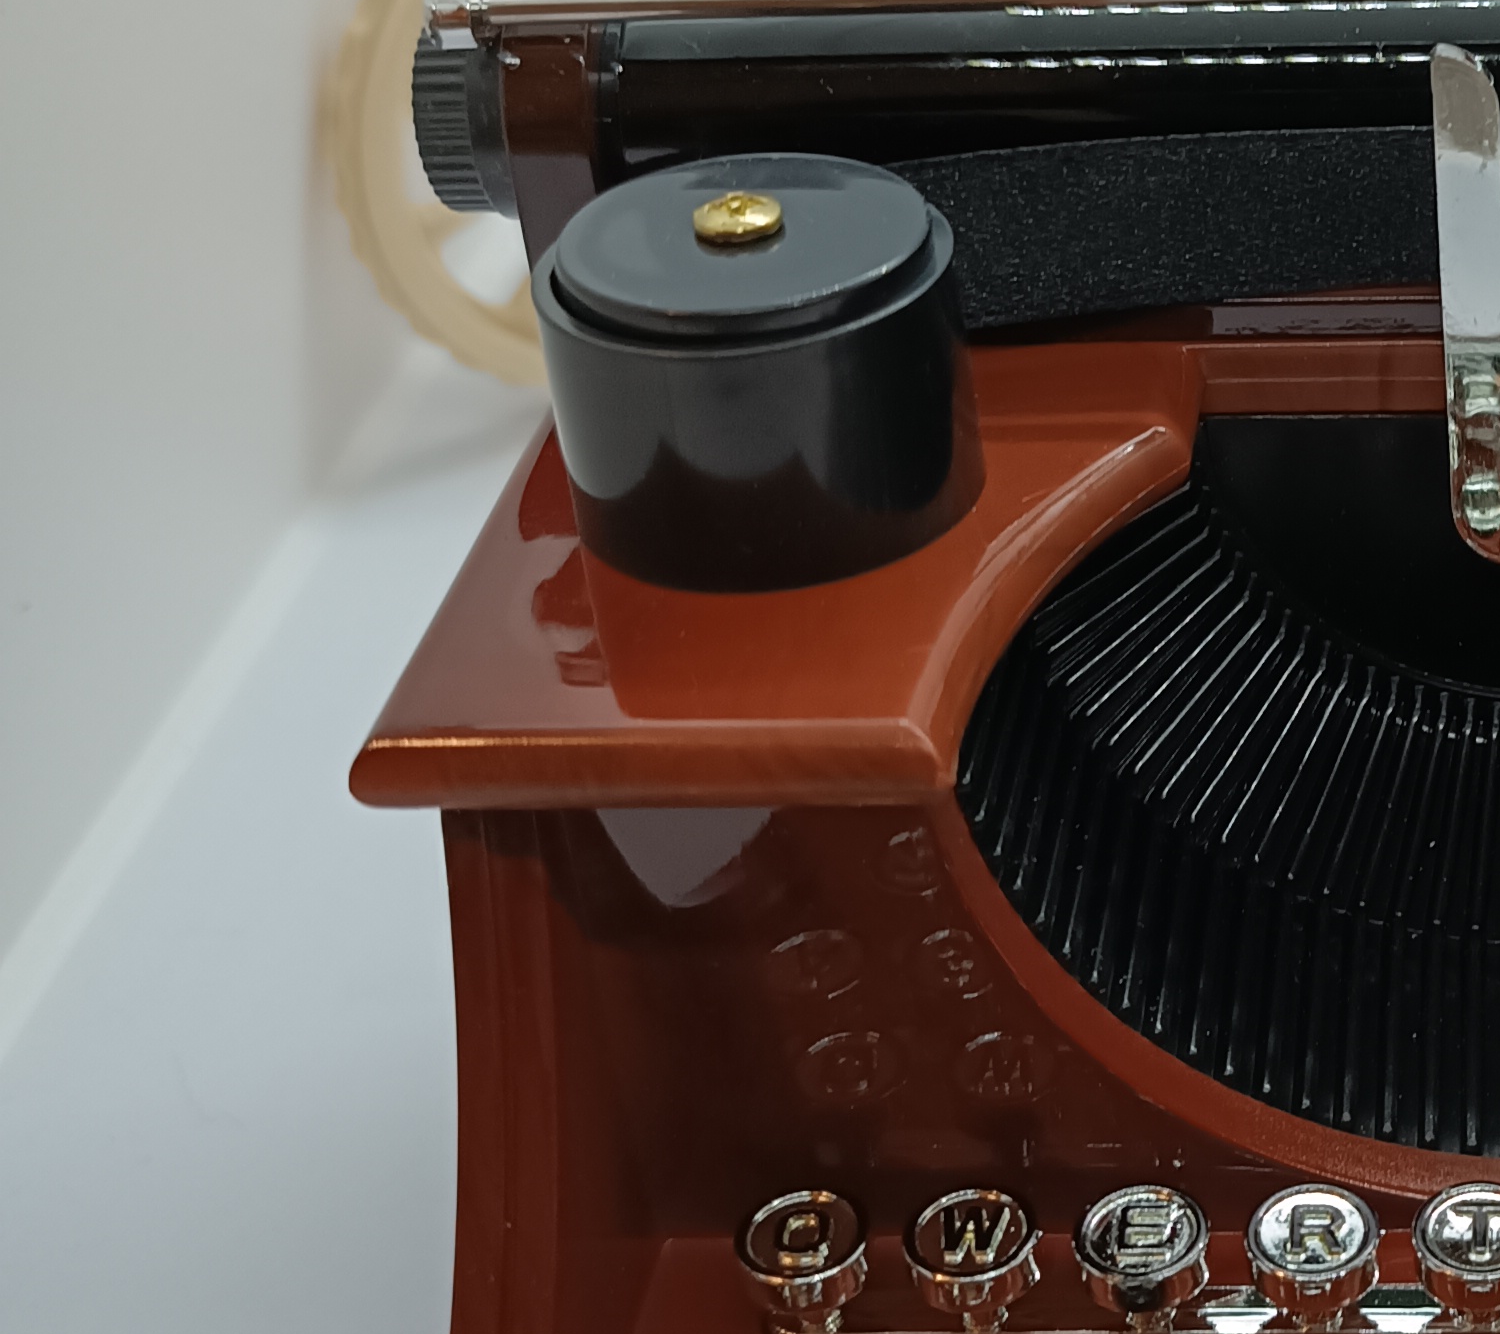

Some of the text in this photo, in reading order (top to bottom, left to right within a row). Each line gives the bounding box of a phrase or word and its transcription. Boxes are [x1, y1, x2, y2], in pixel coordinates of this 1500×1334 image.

[775, 1210, 830, 1266] Q
[940, 1206, 1010, 1266] W
[1114, 1204, 1176, 1265] E
[1288, 1203, 1345, 1261] R
